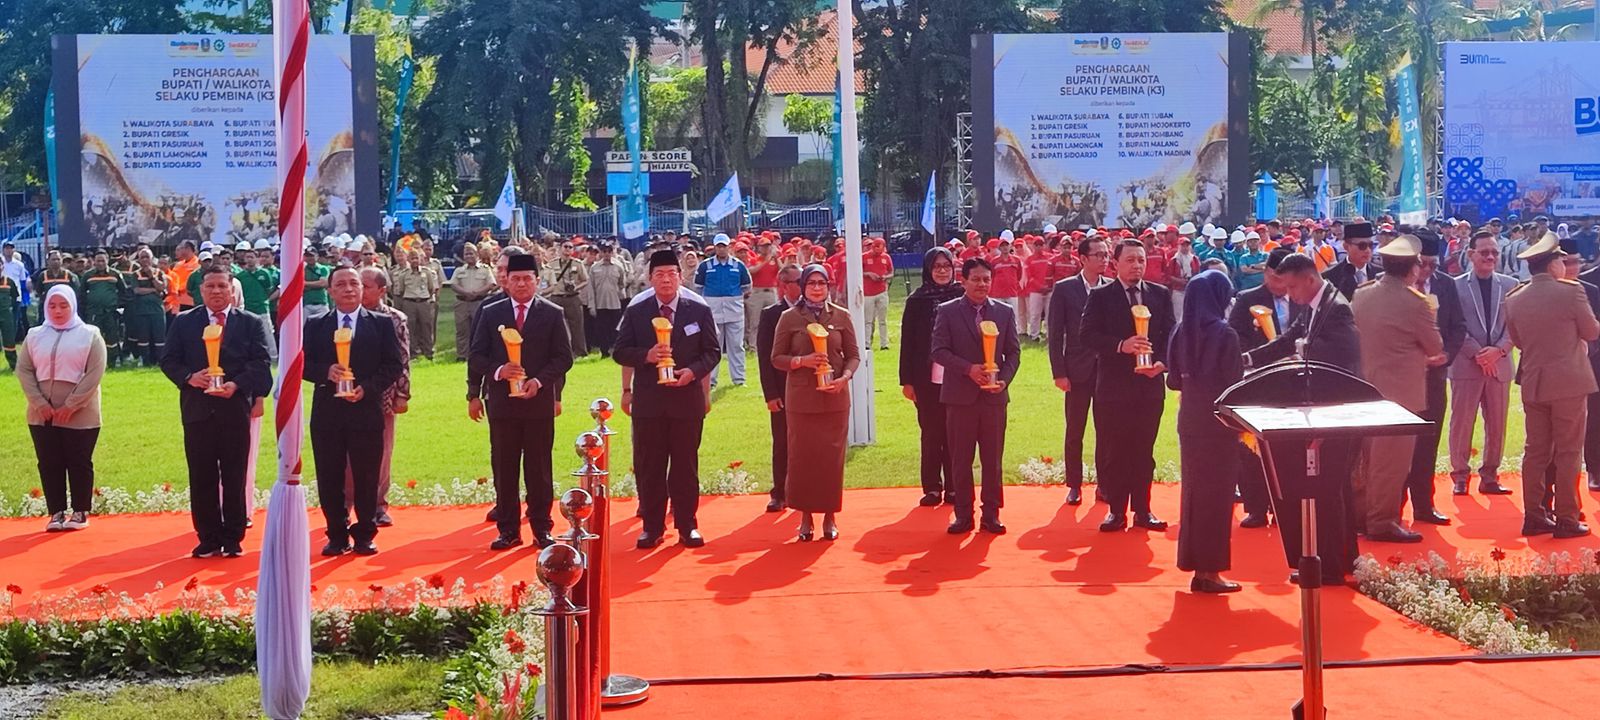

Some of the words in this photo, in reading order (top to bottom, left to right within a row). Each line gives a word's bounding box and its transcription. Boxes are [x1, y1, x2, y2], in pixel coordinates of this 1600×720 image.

[173, 68, 259, 77] PENGHARGAAN
[1076, 65, 1150, 73] PENGHARGAAN
[162, 80, 201, 89] BUPATI
[205, 80, 210, 89] /
[212, 80, 271, 89] WALIKOTA
[1066, 75, 1101, 85] BUPATI
[1103, 75, 1107, 86] /
[1110, 75, 1160, 84] WALIKOTA
[156, 92, 199, 101] SELAKU
[203, 91, 254, 100] PEMBINA
[1060, 87, 1097, 96] SELAKU
[1101, 86, 1144, 95] PEMBINA
[1147, 86, 1165, 97] (K3)
